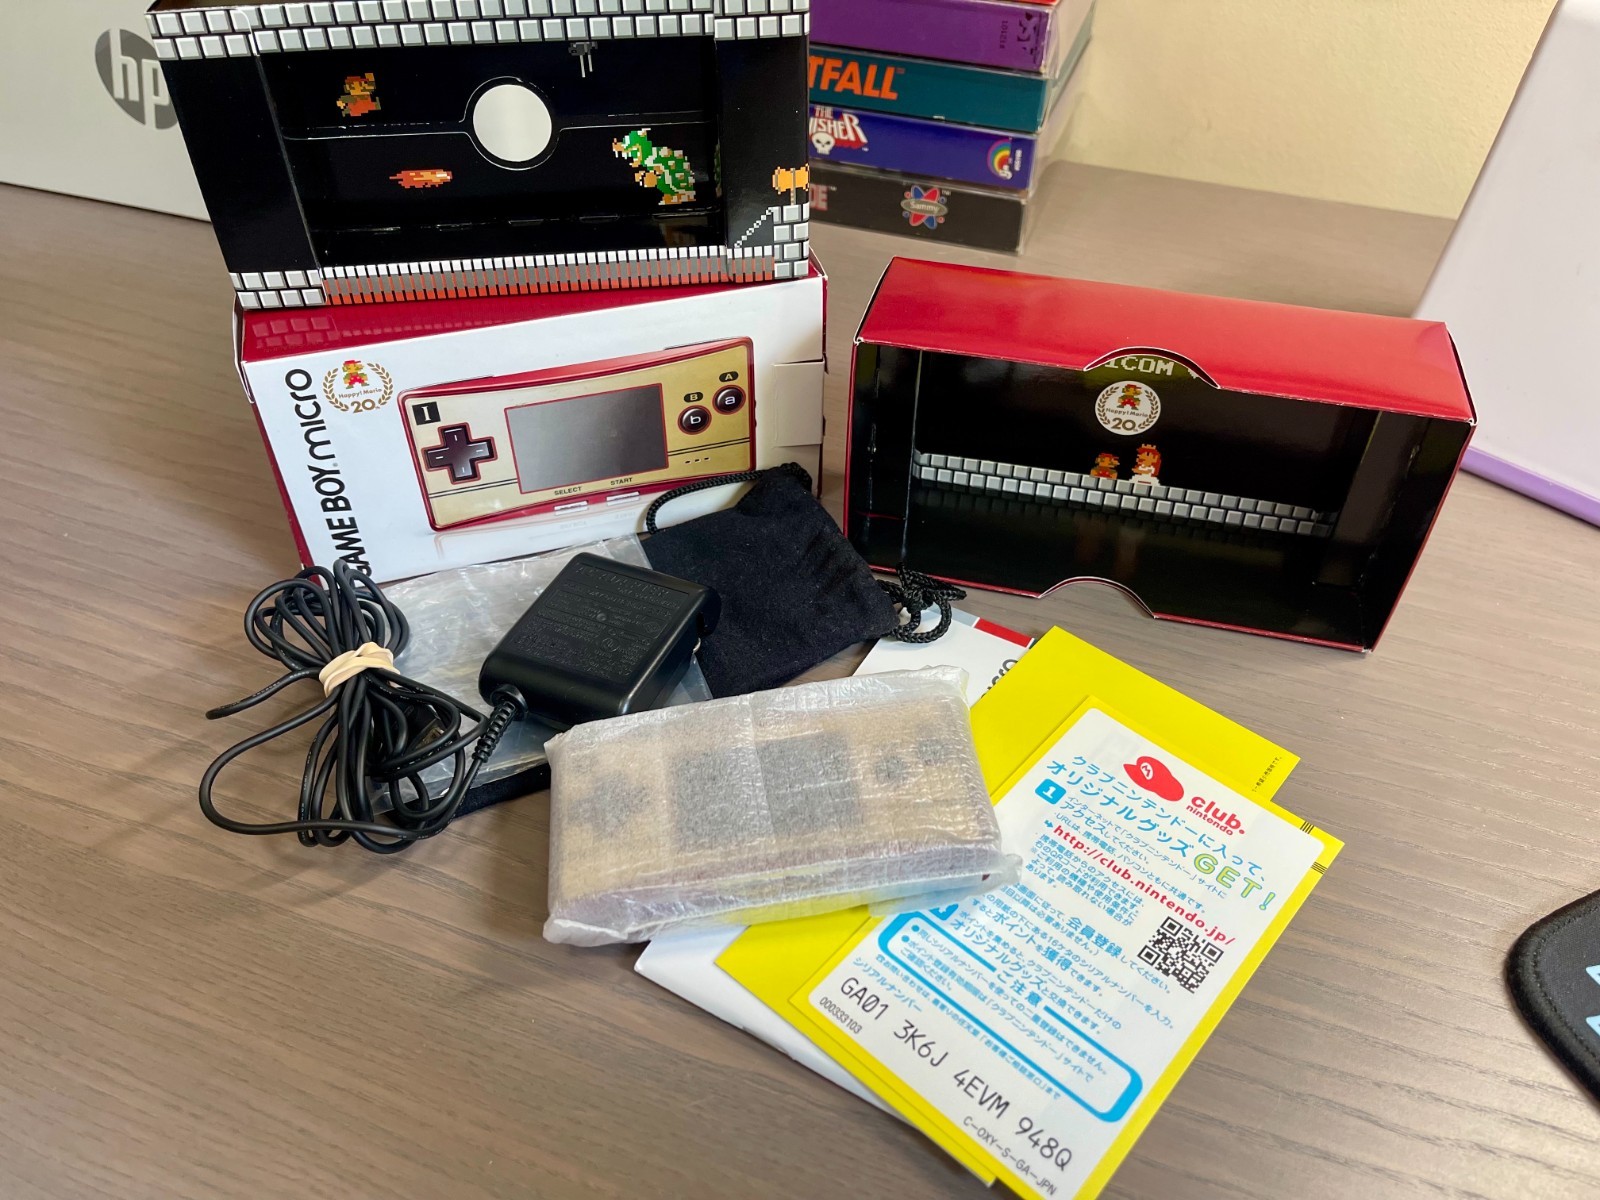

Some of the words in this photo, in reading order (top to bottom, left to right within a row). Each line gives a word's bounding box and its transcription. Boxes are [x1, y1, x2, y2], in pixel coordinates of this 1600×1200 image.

[109, 28, 170, 130] hp
[814, 105, 834, 119] THE
[909, 201, 940, 214] Sammy
[338, 390, 363, 399] Happy!
[363, 387, 382, 396] Mario
[307, 465, 352, 513] BOY
[554, 486, 582, 496] SELECT
[610, 477, 633, 486] START
[1041, 783, 1060, 799] 1
[1046, 760, 1193, 857] オリジナルグッズ
[1059, 800, 1148, 864] アクセスしてください。
[1072, 756, 1264, 881] クラブニンテンドーに入って、
[1185, 805, 1233, 835] nintendo
[1025, 863, 1055, 887] あります。
[1053, 825, 1235, 944] http://club.nintendo.jp/
[852, 957, 922, 1012] シリアルナンバー
[819, 996, 862, 1034] 000333103
[840, 977, 888, 1020] GA01
[893, 1019, 948, 1066] 3K6J
[953, 1069, 1010, 1119] 4EVM
[1015, 1116, 1072, 1171] 948Q
